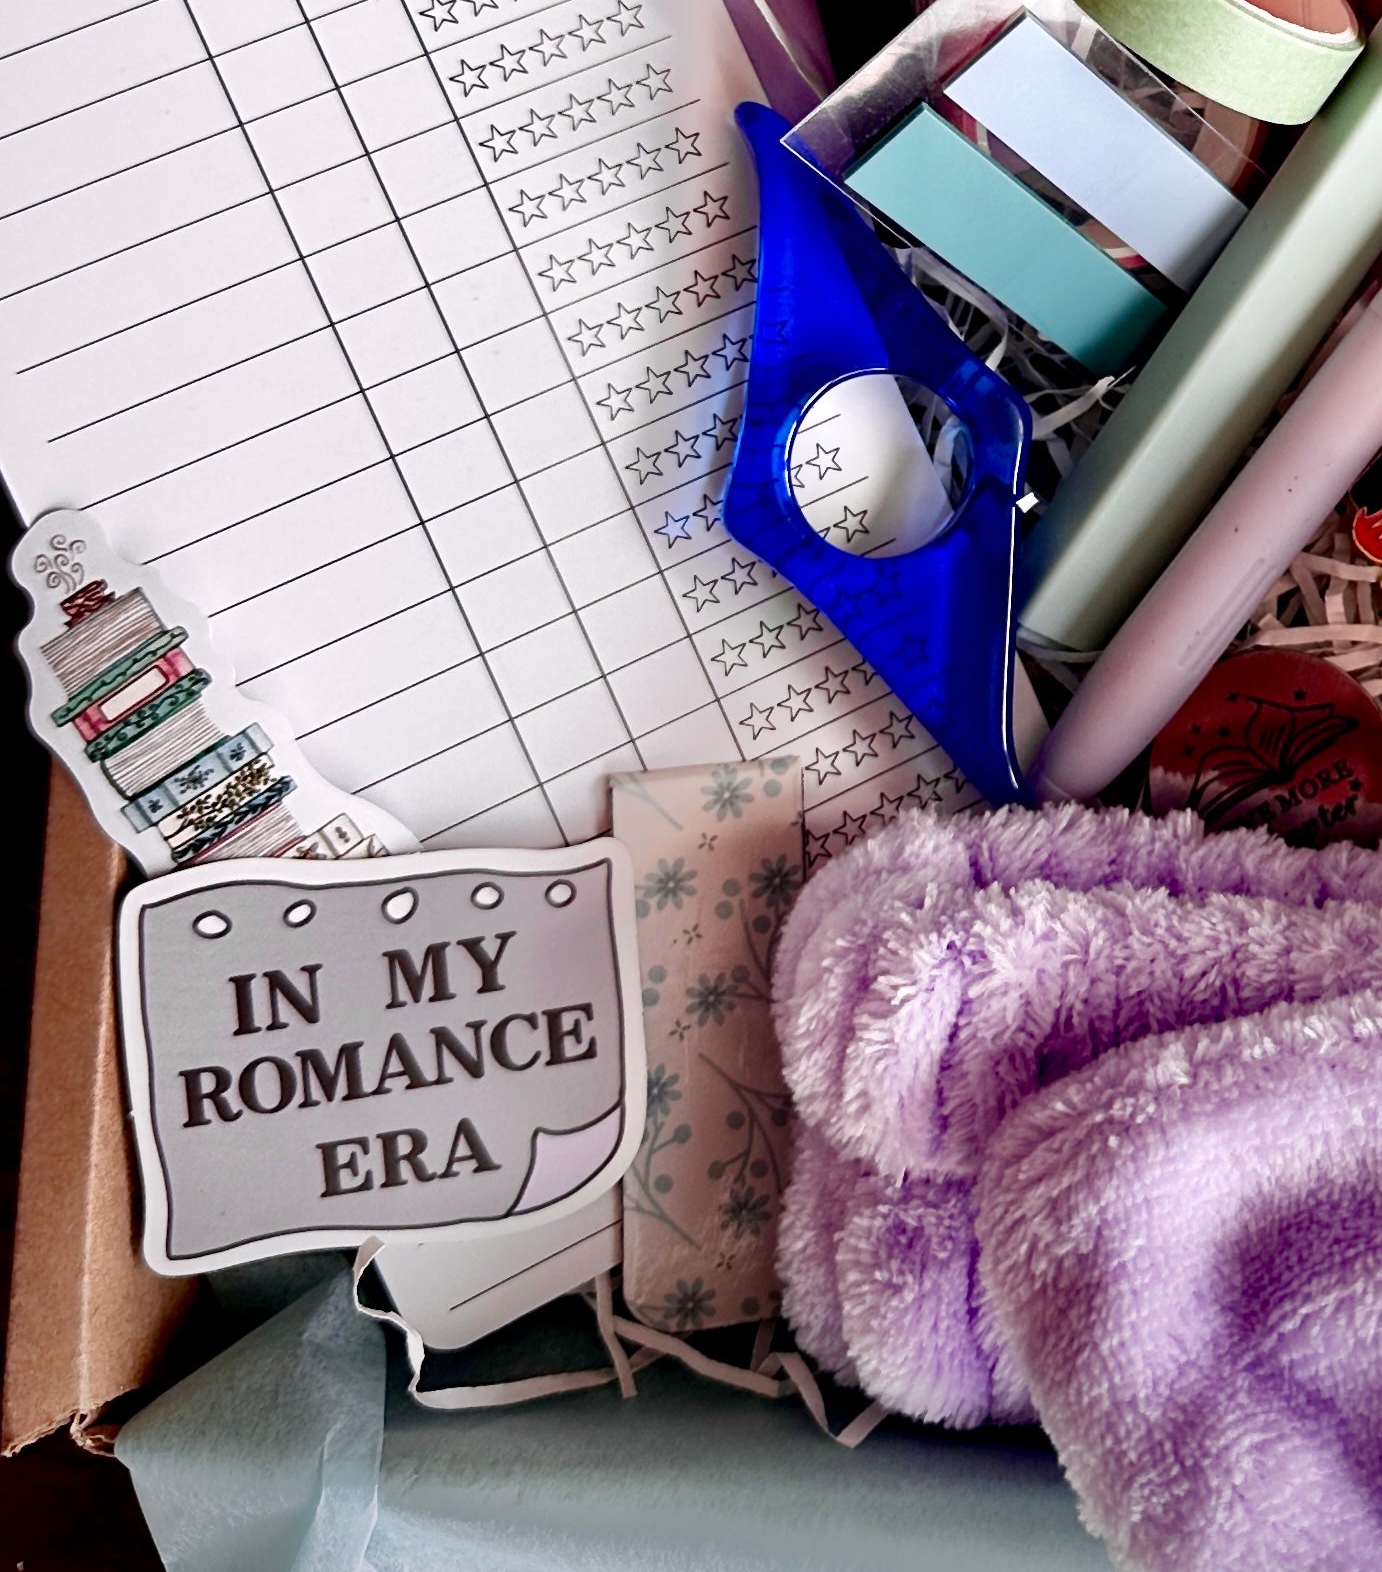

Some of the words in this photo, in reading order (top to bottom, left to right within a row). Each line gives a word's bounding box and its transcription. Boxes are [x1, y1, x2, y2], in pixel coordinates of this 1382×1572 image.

[1274, 759, 1355, 815] MORE
[227, 963, 324, 1037] IN
[382, 929, 518, 1010] MY
[178, 1001, 598, 1129] ROMANCE
[314, 1117, 502, 1198] ERA
